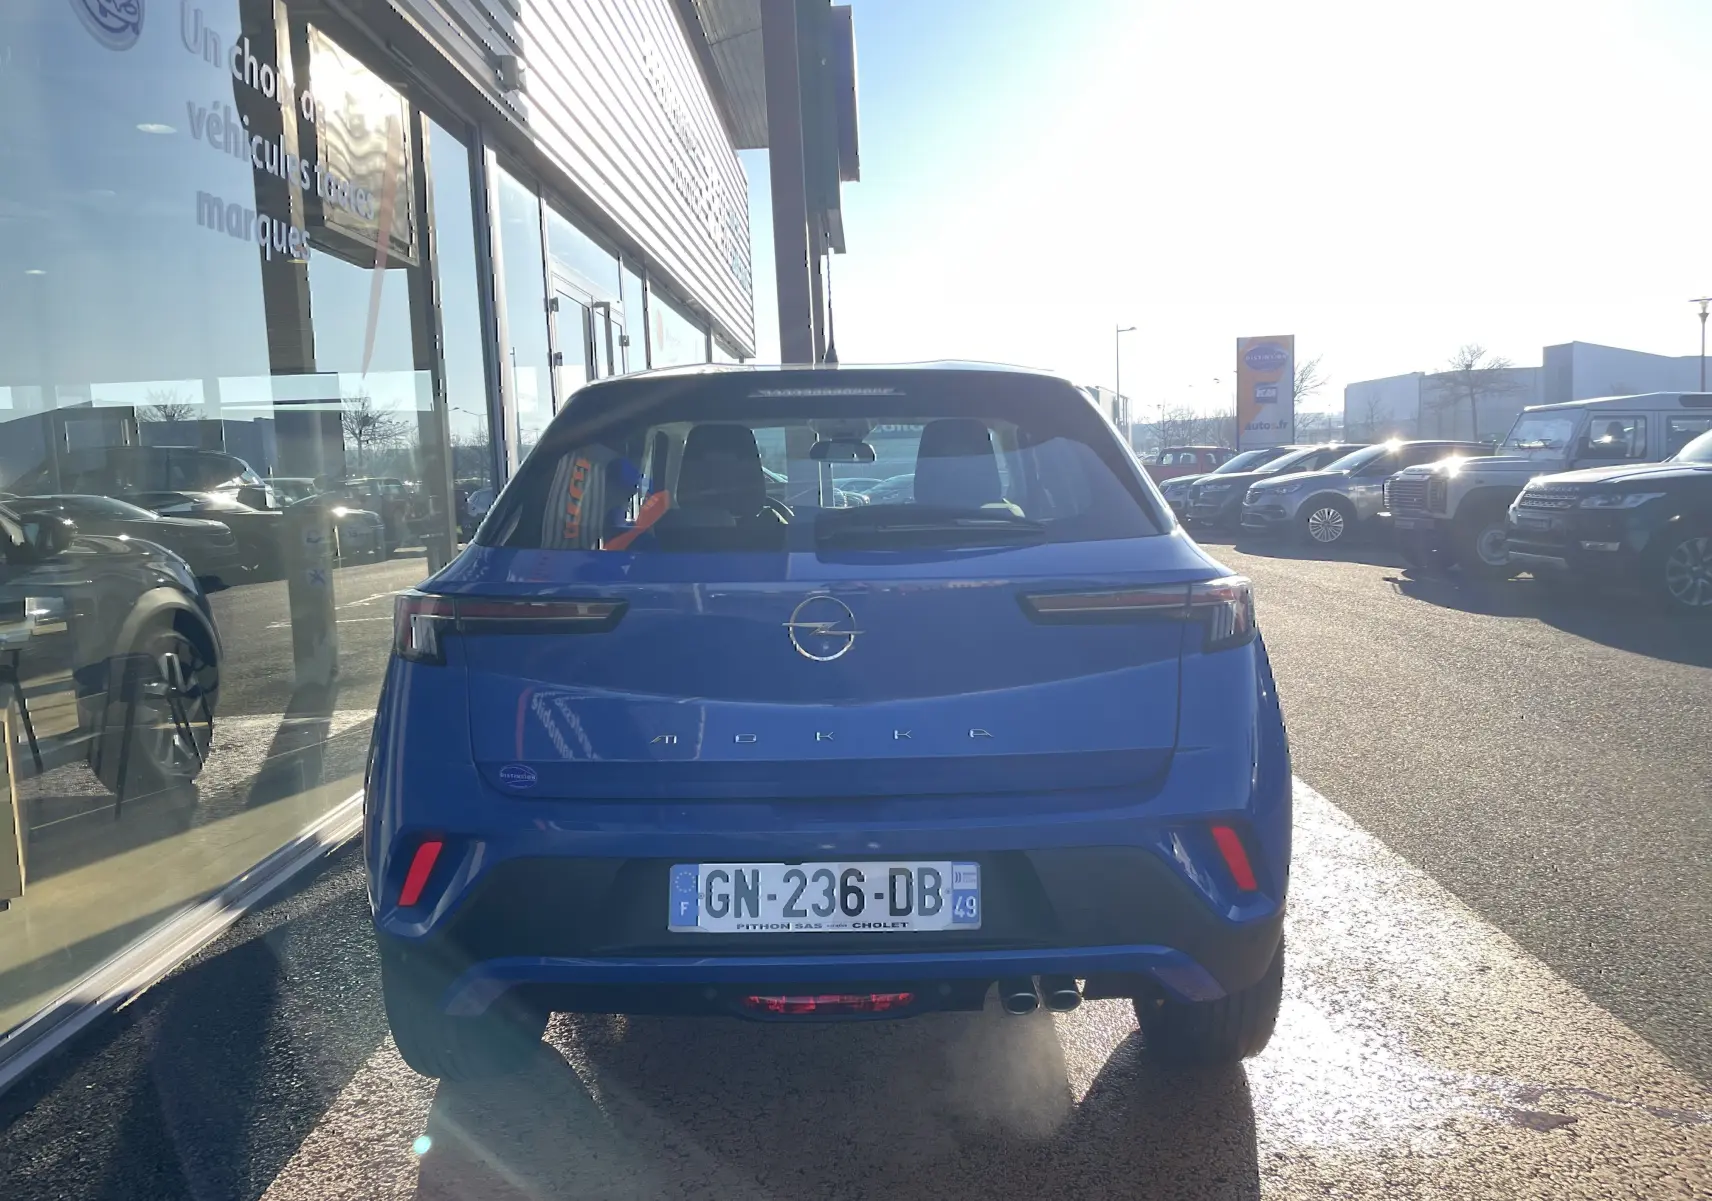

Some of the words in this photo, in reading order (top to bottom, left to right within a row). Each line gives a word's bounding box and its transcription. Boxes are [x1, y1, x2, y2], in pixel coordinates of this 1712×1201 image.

[179, 7, 222, 68] Un
[196, 190, 311, 261] marques
[679, 900, 689, 916] F
[704, 867, 944, 919] GN-236-DB
[954, 896, 977, 918] 49
[794, 922, 822, 930] SAS
[852, 921, 909, 929] CHOLET
